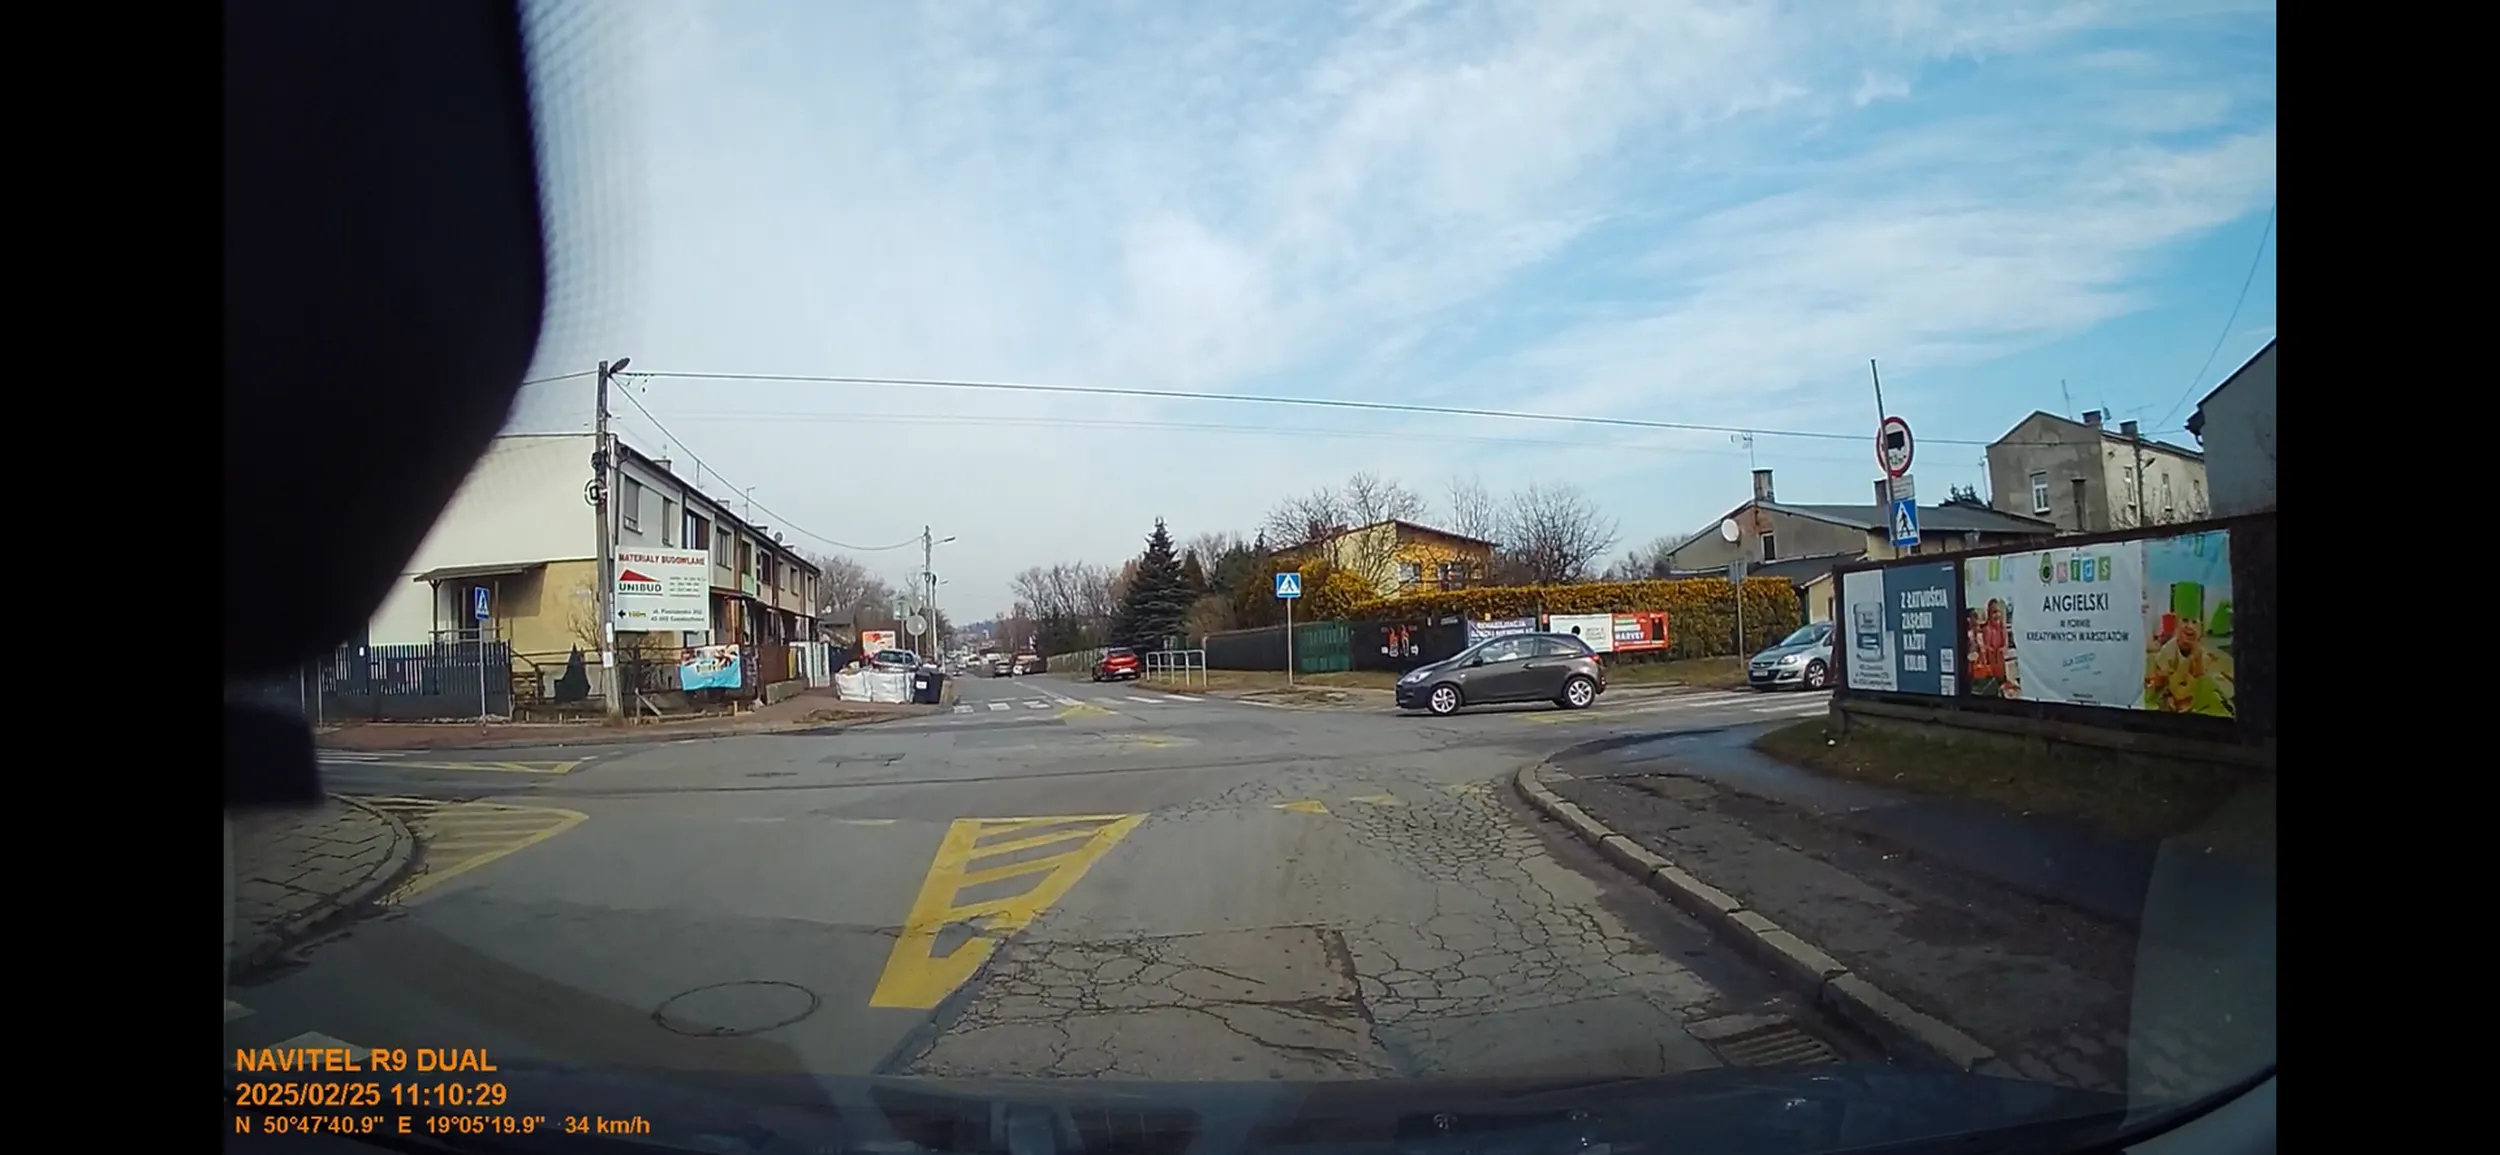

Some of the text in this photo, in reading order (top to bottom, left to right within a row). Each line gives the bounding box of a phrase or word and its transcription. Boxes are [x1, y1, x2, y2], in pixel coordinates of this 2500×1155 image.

[619, 583, 662, 592] UNIBUD
[1900, 592, 1906, 609] Z
[2042, 592, 2110, 612] ANGIELSKI
[2067, 618, 2091, 628] FORMIE
[1903, 630, 1926, 650] KAŻDY
[2026, 630, 2129, 642] KREATYWNYCH WARSZTATÓW
[1904, 654, 1928, 672] KOLOR
